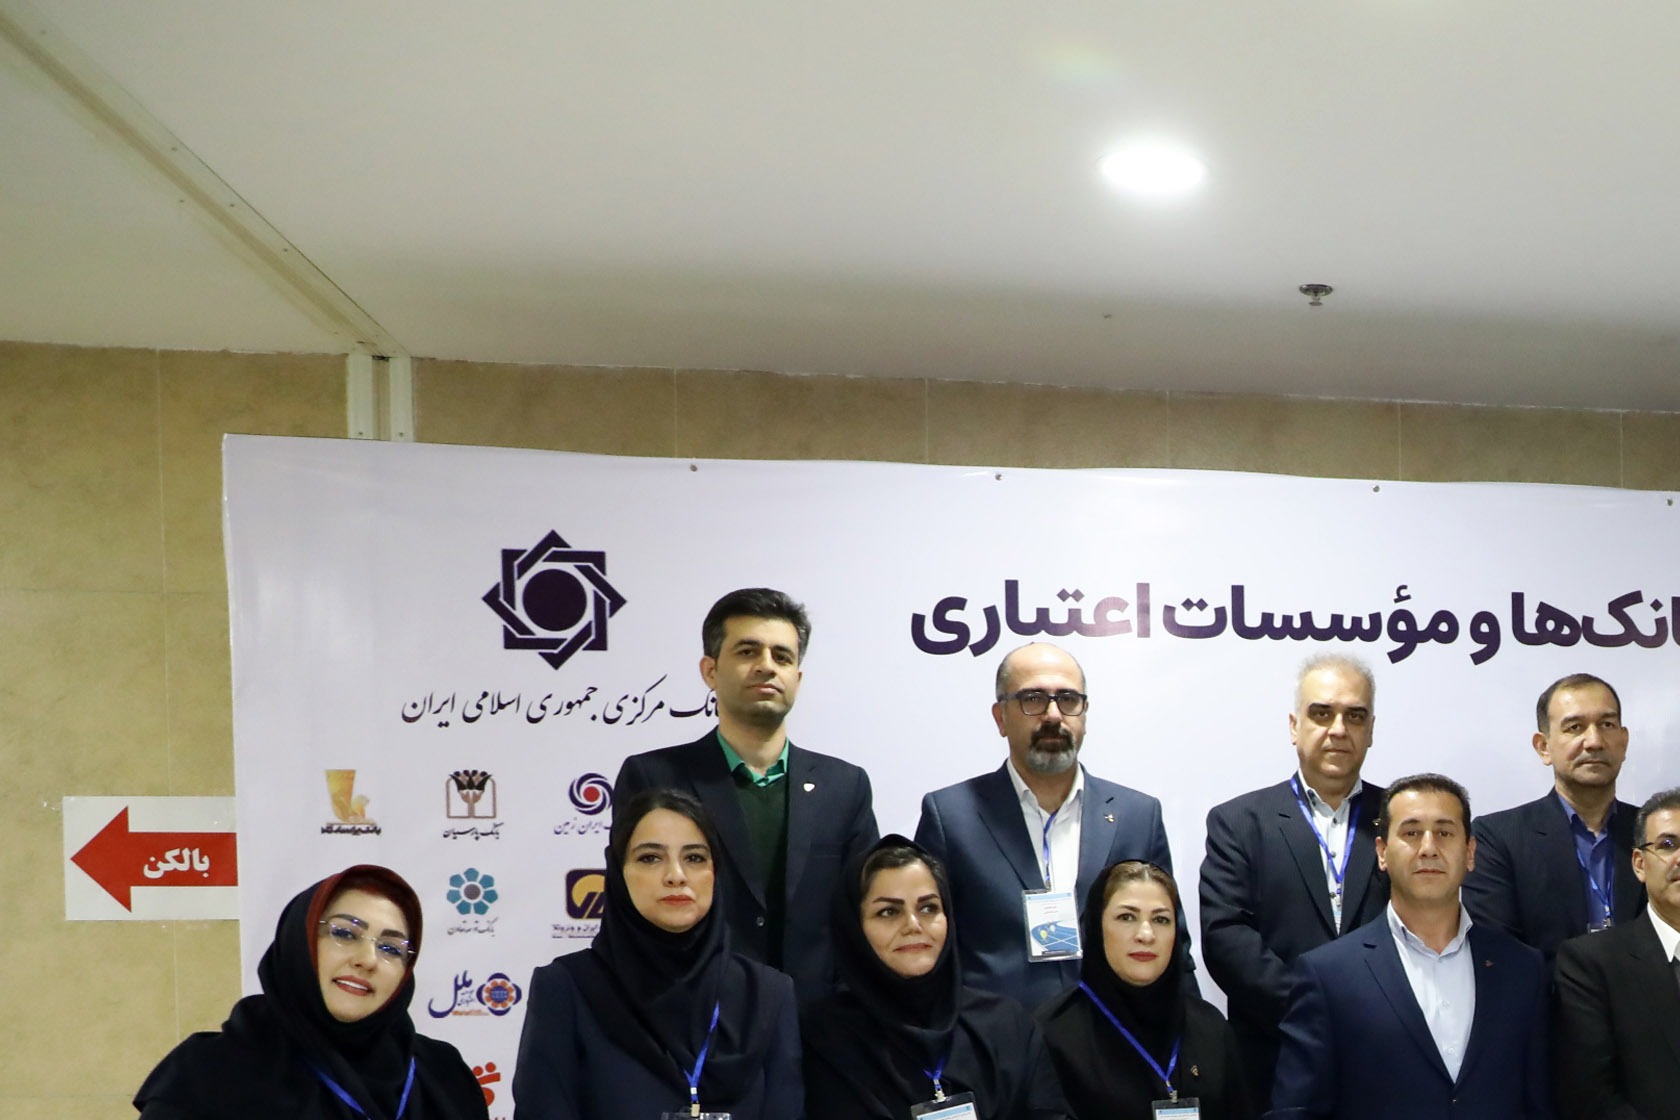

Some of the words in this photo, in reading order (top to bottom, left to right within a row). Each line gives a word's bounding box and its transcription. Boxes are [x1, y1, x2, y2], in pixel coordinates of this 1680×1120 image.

[911, 579, 1151, 658] اعتباری
[1162, 585, 1460, 665] مؤسسات
[1469, 608, 1501, 666] و
[401, 691, 456, 728] ایران
[462, 690, 520, 724] اسلامی
[526, 686, 599, 724] جمهوری
[603, 674, 667, 726] مرکزی
[669, 688, 719, 718] انک
[143, 847, 210, 879] بالکن
